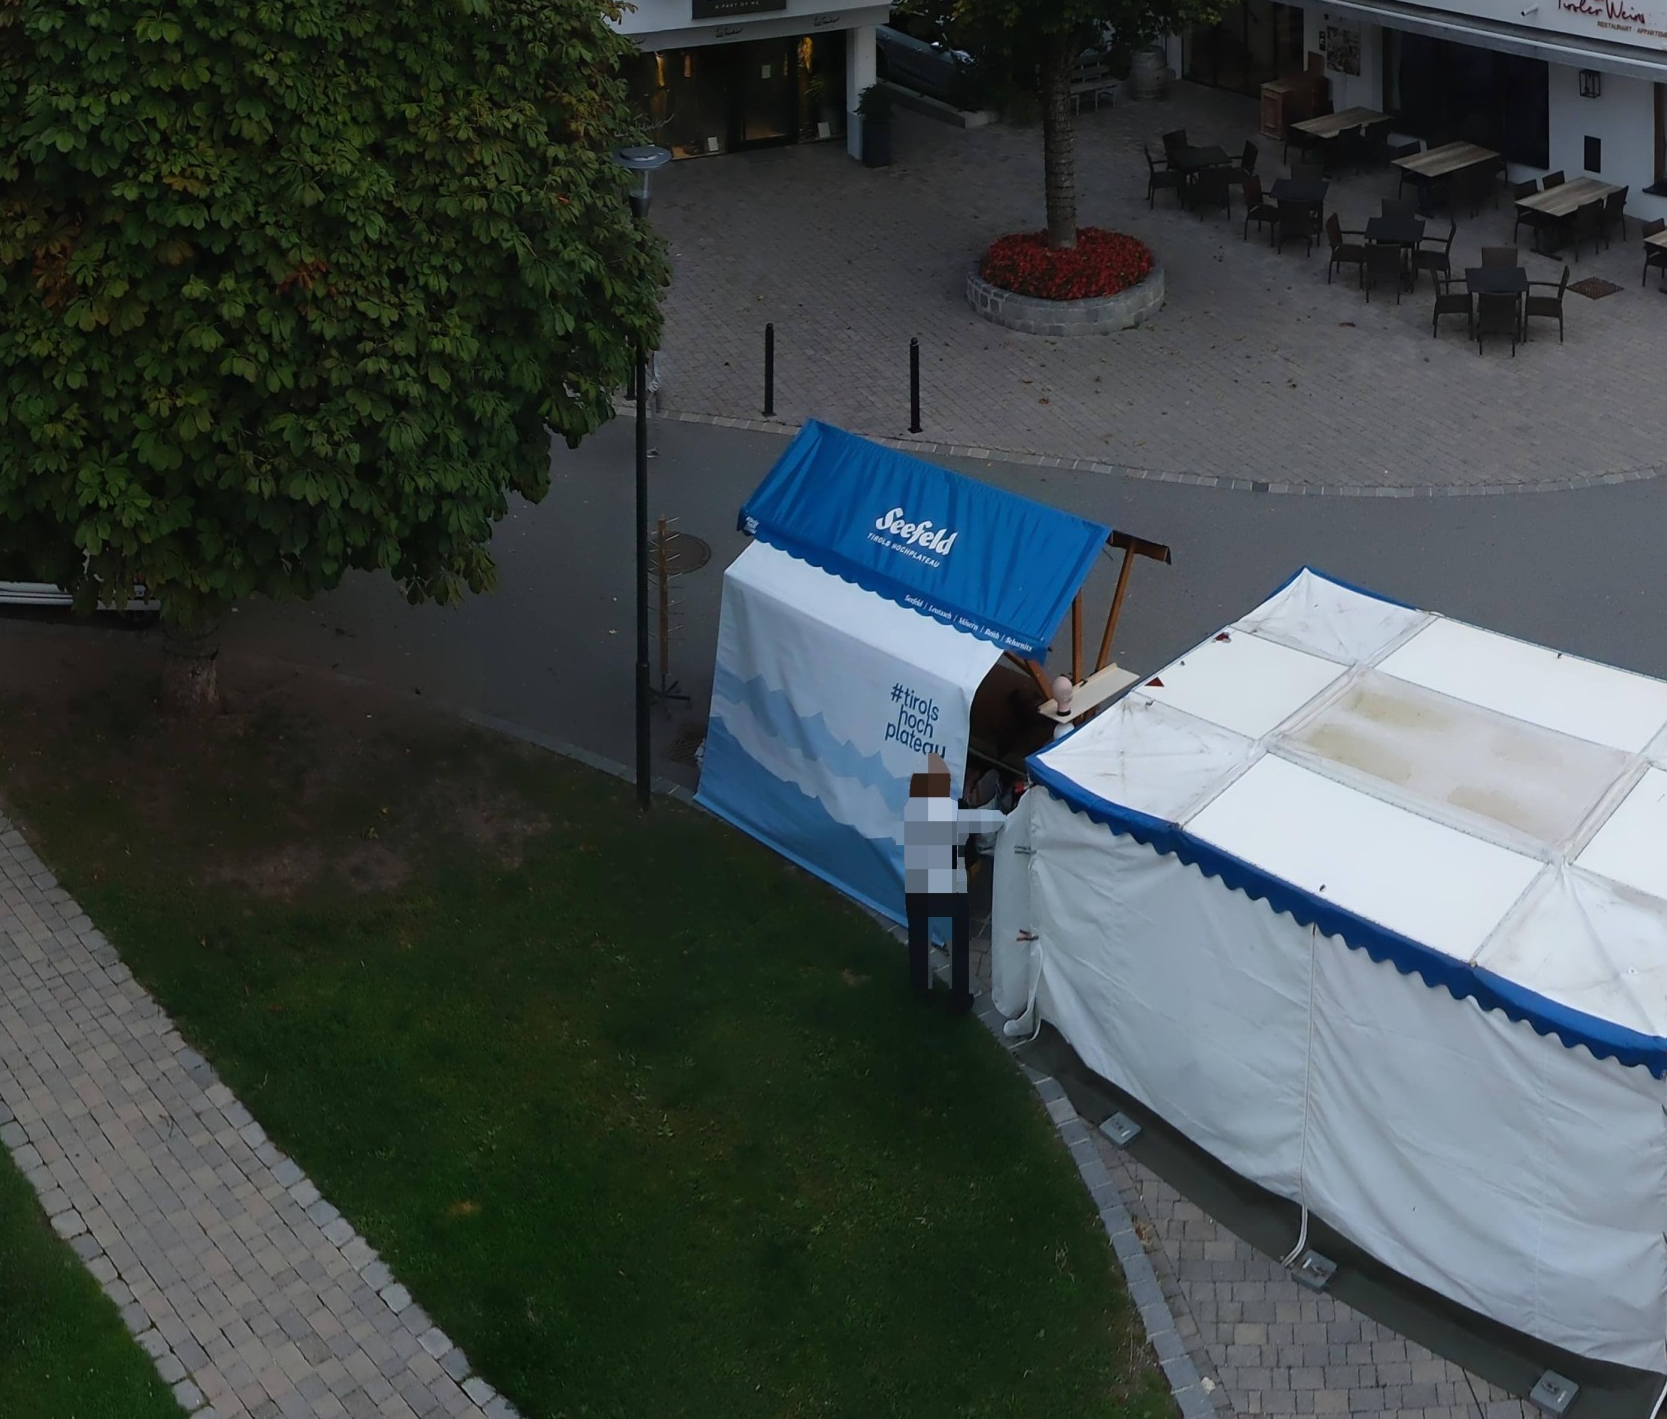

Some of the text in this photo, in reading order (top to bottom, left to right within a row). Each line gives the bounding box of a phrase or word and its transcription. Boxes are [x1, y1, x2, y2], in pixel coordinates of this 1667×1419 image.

[867, 532, 892, 549] TIROLS
[875, 507, 958, 556] Seefeld
[890, 682, 940, 722] #tirols
[899, 703, 934, 738] hoch
[885, 721, 946, 758] plateau
